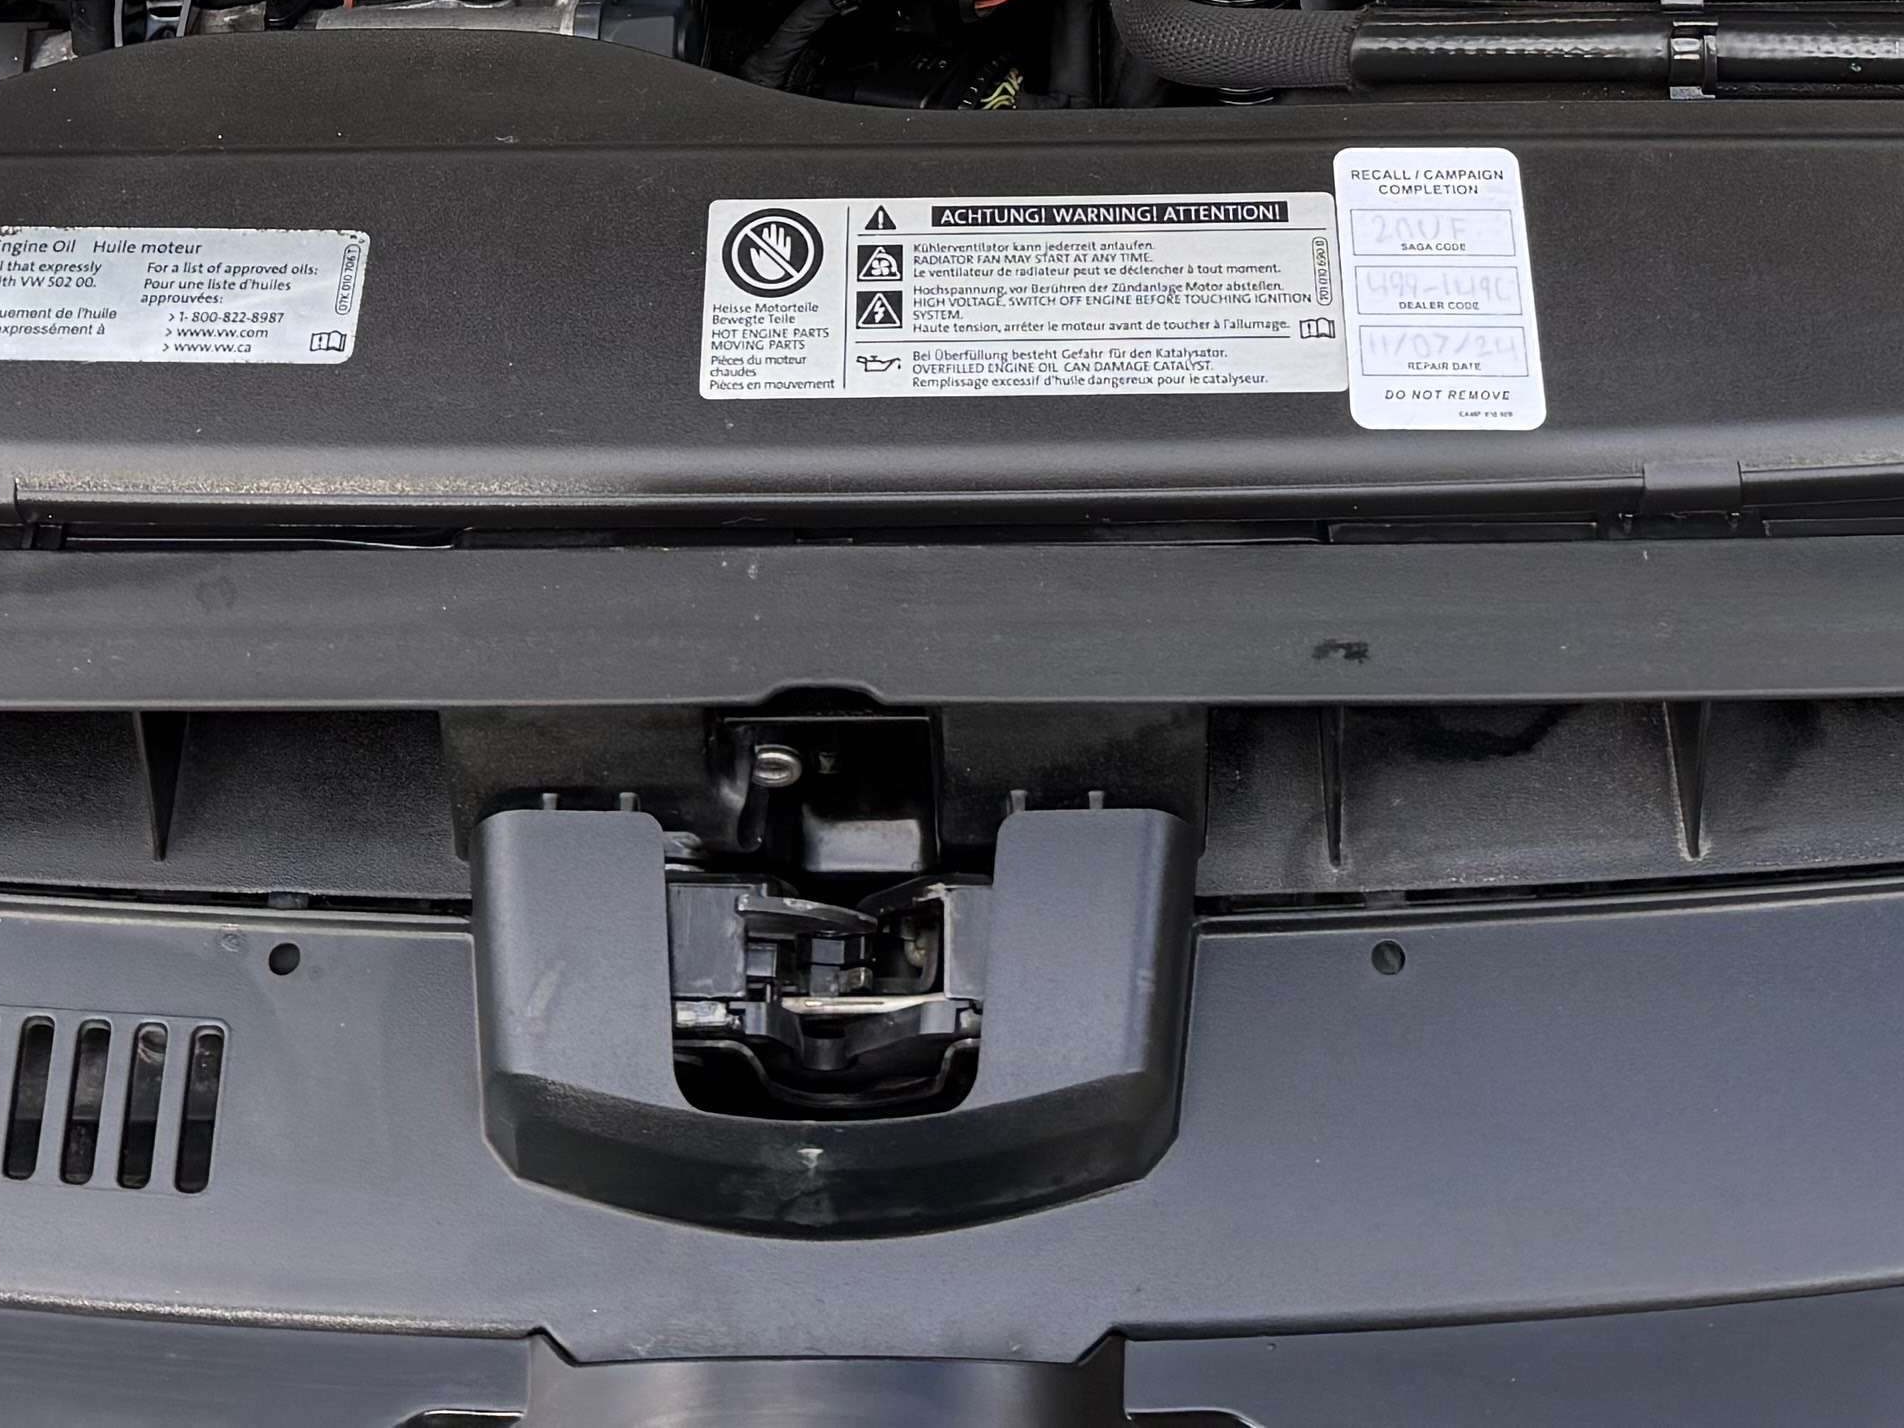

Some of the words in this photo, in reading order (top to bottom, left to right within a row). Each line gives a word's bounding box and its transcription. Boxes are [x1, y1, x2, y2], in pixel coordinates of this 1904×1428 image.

[1351, 170, 1411, 180] RECALL
[1424, 170, 1504, 180] CAMPAIGN
[1378, 184, 1479, 195] COMPLETION
[941, 208, 1045, 224] ACHTUNG!
[1053, 205, 1158, 222] WARNING!
[1164, 204, 1280, 221] ATTENTION!
[52, 239, 76, 253] Oil
[93, 240, 136, 254] Huile
[141, 243, 203, 254] moteur
[914, 242, 1009, 252] Kühlerventilator
[1013, 242, 1041, 252] kann
[1045, 242, 1096, 253] jederzeit
[1401, 243, 1432, 251] SAGA
[1436, 243, 1466, 251] CODE
[914, 255, 974, 265] RADIATOR
[977, 254, 1000, 264] FAN
[1004, 254, 1031, 264] MAY
[1035, 253, 1069, 263] START
[1074, 253, 1087, 263] AT
[1092, 254, 1117, 263] ANY
[1121, 253, 1153, 263] TIME.
[7, 261, 35, 272] that
[39, 261, 102, 275] expressly
[147, 263, 167, 274] For
[171, 265, 179, 274] a
[183, 263, 203, 274] list
[207, 263, 222, 274] of
[223, 263, 287, 276] approved
[291, 264, 318, 275] oils:
[914, 268, 925, 278] Le
[929, 268, 994, 277] ventilateur
[997, 268, 1011, 277] de
[1016, 267, 1069, 276] radiateur
[1074, 267, 1101, 278] peut
[1120, 264, 1184, 275] déclencher
[1198, 264, 1222, 274] tout
[1226, 264, 1281, 274] moment.
[21, 276, 44, 288] VW
[47, 276, 71, 288] 502
[76, 276, 96, 288] 00.
[144, 279, 175, 290] Pour
[178, 279, 204, 290] une
[207, 279, 235, 290] liste
[239, 280, 291, 291] d'huiles
[914, 285, 1007, 297] Hochspannung,
[1010, 285, 1028, 294] vor
[1089, 284, 1108, 293] der
[1112, 282, 1182, 295] Zündanlage
[1185, 282, 1224, 291] Motor
[140, 292, 223, 305] approuvées:
[914, 297, 945, 307] HIGH
[1009, 297, 1056, 307] SWITCH
[1059, 297, 1082, 307] OFF
[1086, 295, 1132, 305] ENGINE
[1136, 294, 1181, 304] BEFORE
[1185, 294, 1251, 304] TOUCHING
[1255, 293, 1311, 304] IGNITION
[1399, 302, 1445, 310] DEALER
[1448, 302, 1479, 310] CODE
[55, 307, 73, 319] de
[77, 308, 117, 319] l'huile
[913, 310, 963, 320] SYSTEM.
[712, 314, 765, 326] Bewegte
[768, 314, 796, 324] Teile
[97, 323, 105, 335] à
[913, 324, 952, 333] Haute
[953, 324, 1001, 334] tension,
[1048, 322, 1058, 331] le
[1061, 322, 1105, 331] moteur
[1109, 321, 1142, 330] avant
[1146, 320, 1160, 330] de
[1164, 320, 1209, 330] toucher
[177, 329, 268, 338] www.vw.com
[712, 329, 737, 339] HOT
[742, 329, 788, 339] ENGINE
[793, 328, 829, 338] PARTS
[174, 343, 251, 353] www.vw.ca
[711, 340, 764, 350] MOVING
[769, 340, 805, 350] PARTS
[913, 351, 931, 361] Bei
[1012, 350, 1057, 360] besteht
[1062, 349, 1103, 359] Gefahr
[1109, 348, 1126, 359] für
[1130, 348, 1152, 359] den
[710, 367, 756, 377] chaudes
[913, 364, 984, 374] OVERFILLED
[988, 364, 1034, 373] ENGINE
[1038, 364, 1058, 373] OIL
[1064, 363, 1090, 372] CAN
[1095, 361, 1149, 371] DAMAGE
[1153, 360, 1213, 371] CATALYST.
[1408, 362, 1449, 371] REPAIR
[1453, 362, 1481, 371] DATE
[913, 377, 988, 390] Remplissage
[992, 377, 1039, 386] excessif
[1044, 375, 1085, 386] d'huile
[1088, 374, 1153, 388] dangereux
[1158, 374, 1185, 386] pour
[1190, 373, 1200, 384] le
[1203, 373, 1268, 386] catalyseur.
[1385, 390, 1405, 400] DO
[1412, 390, 1442, 400] NOT
[1448, 390, 1510, 400] REMOVE
